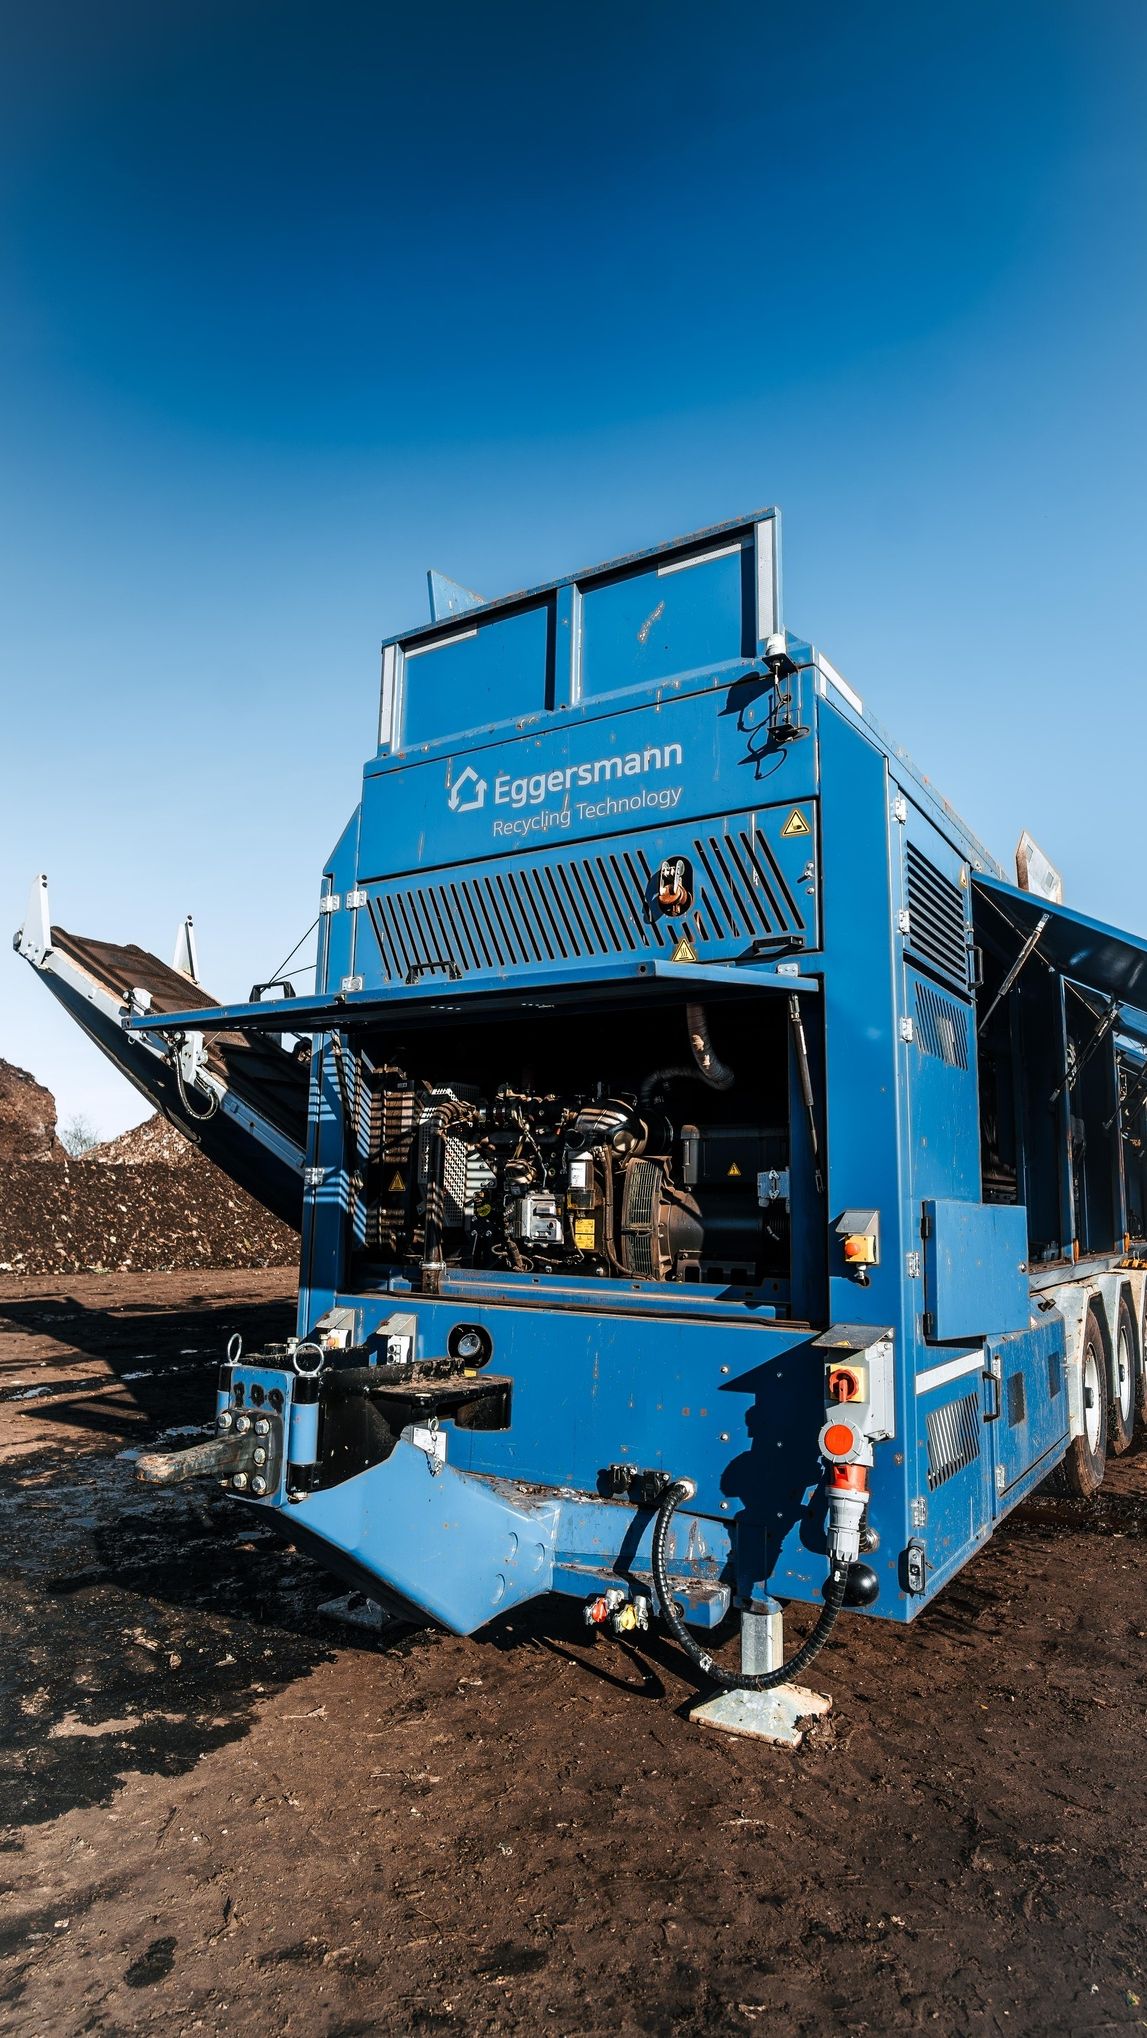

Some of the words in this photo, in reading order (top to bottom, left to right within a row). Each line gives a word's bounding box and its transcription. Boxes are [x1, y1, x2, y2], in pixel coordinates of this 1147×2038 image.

[495, 743, 683, 807] Eggersmann
[493, 810, 571, 837] Recycling
[576, 787, 682, 820] Technology
